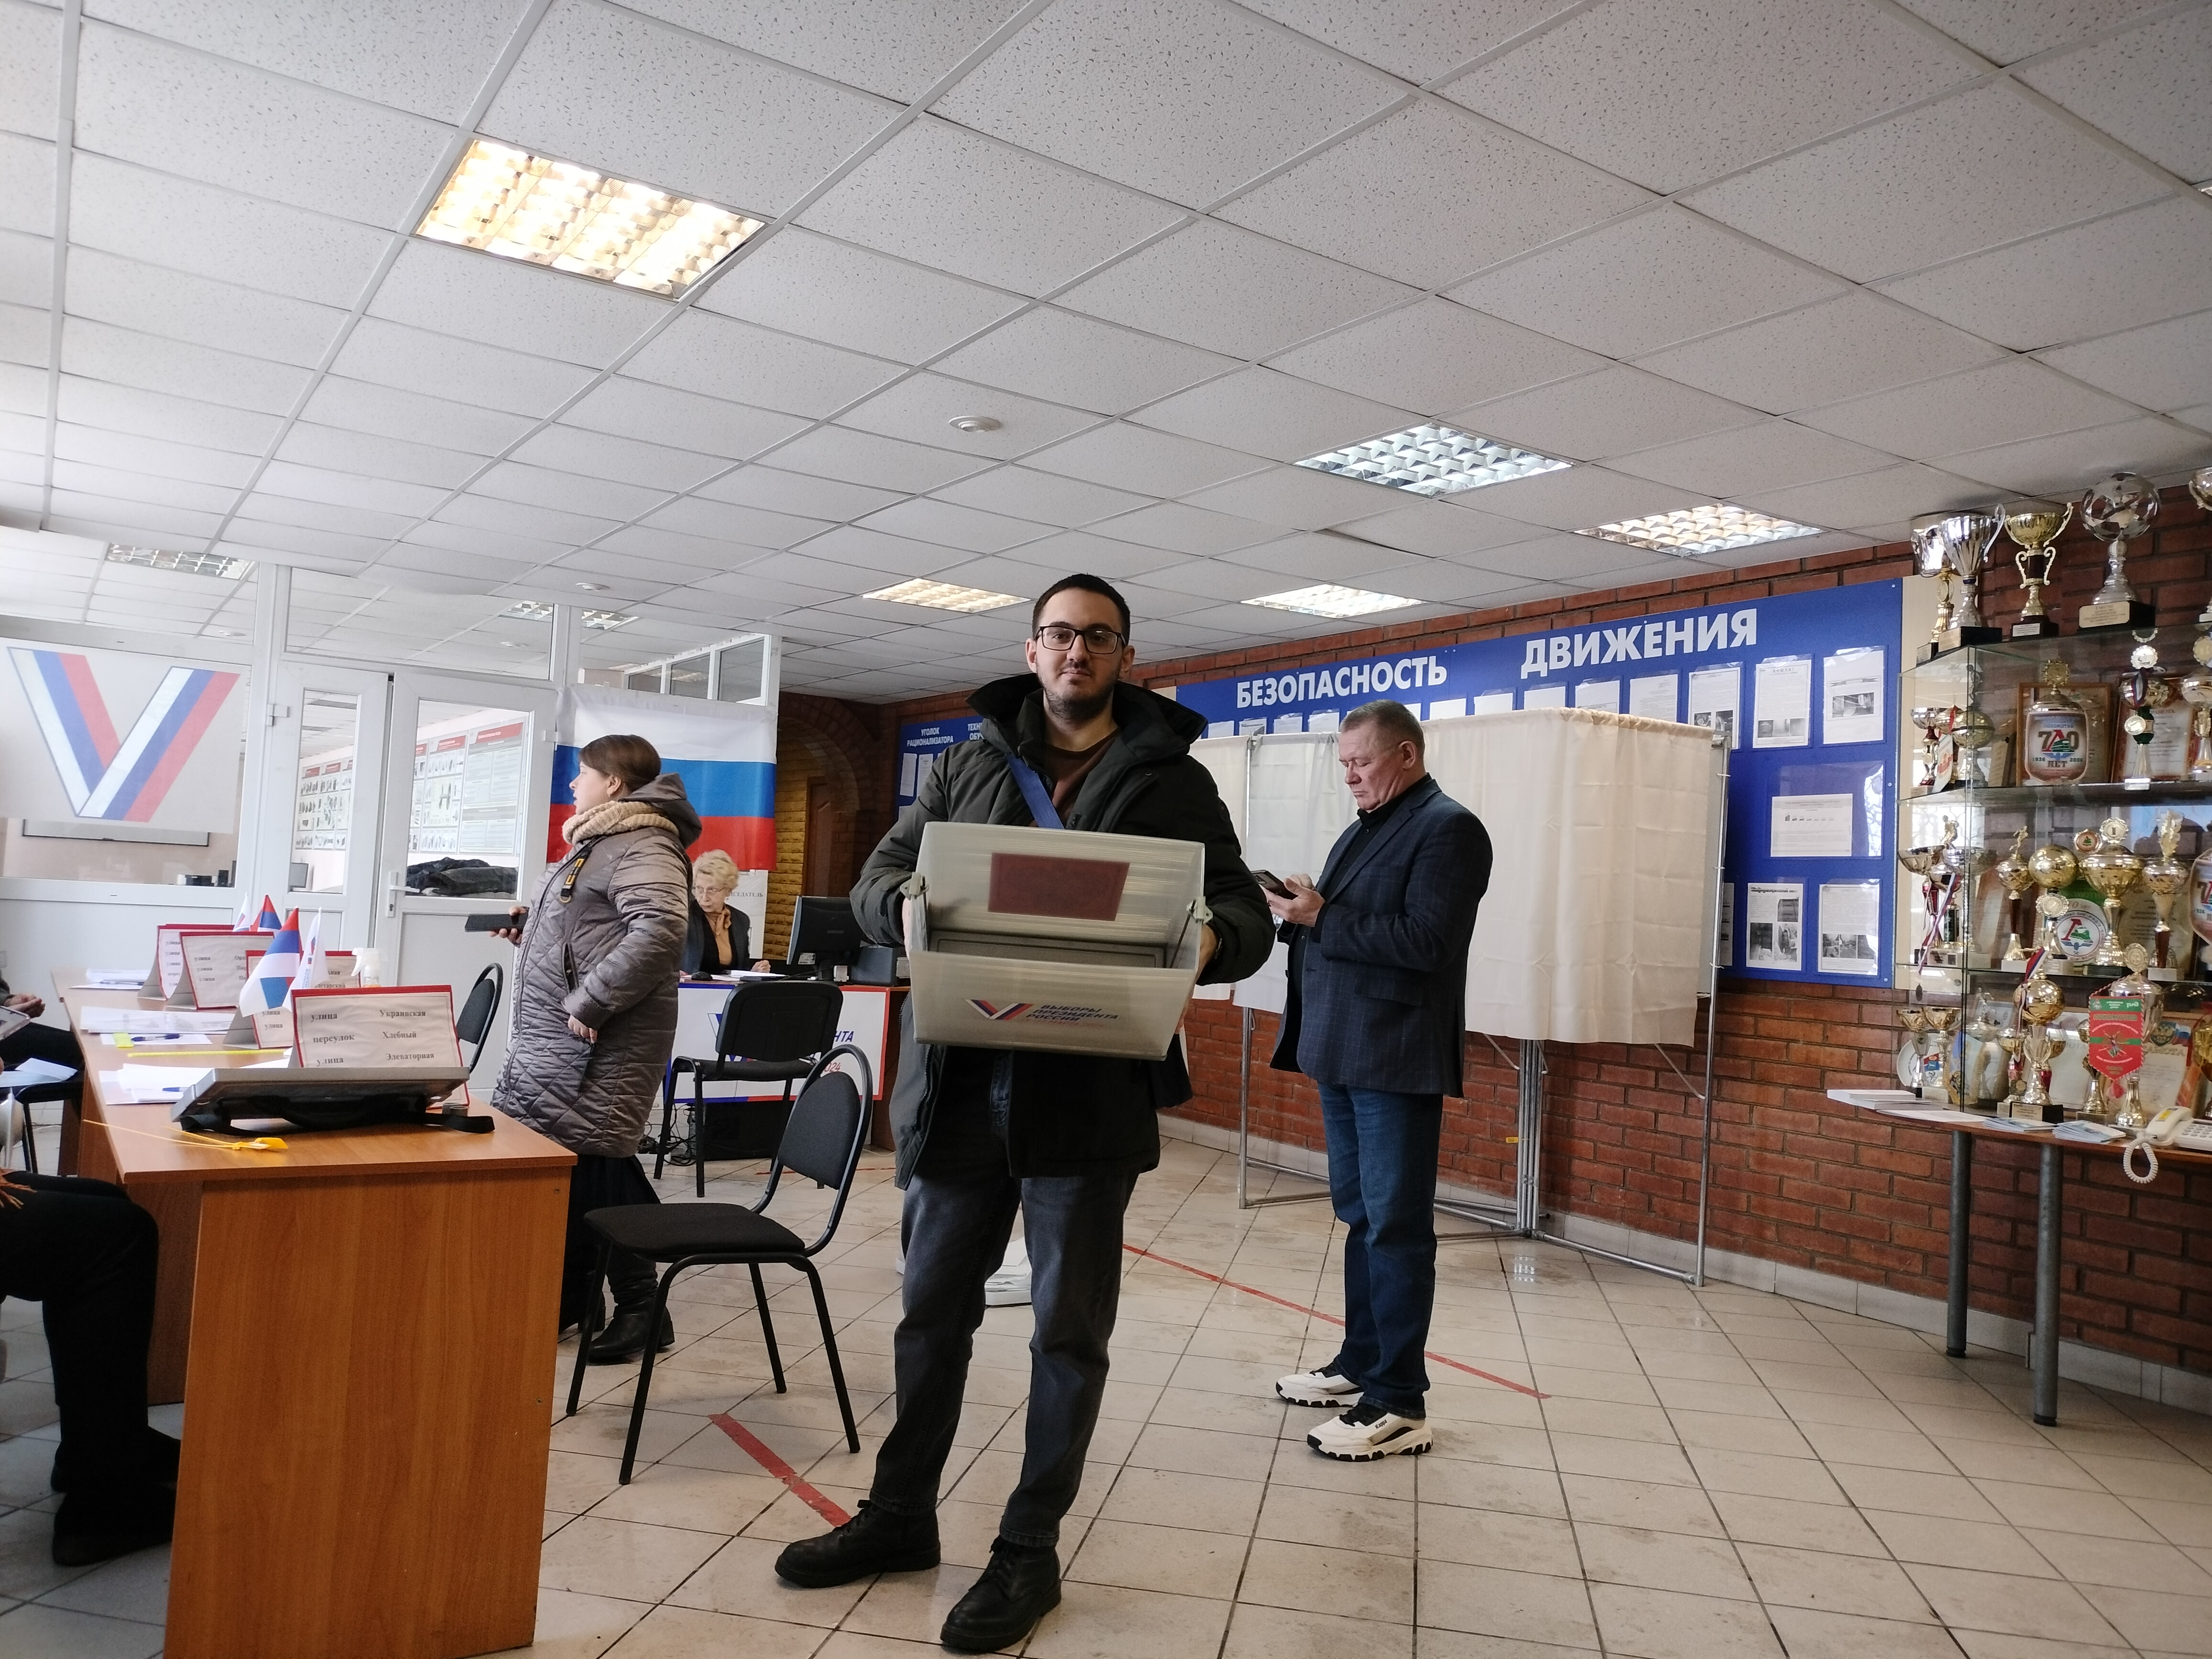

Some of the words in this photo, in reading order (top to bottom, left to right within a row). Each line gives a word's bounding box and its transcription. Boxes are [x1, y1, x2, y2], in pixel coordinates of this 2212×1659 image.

[1237, 655, 1447, 708] БЕЗОПАСНОСТЬ
[1520, 608, 1757, 679] ДВИЖЕНИЯ
[921, 727, 940, 736] УГОЛОК
[967, 722, 983, 731] ТЕХН
[907, 735, 954, 747] РАЦИОНАЛИЗАТОРА
[1033, 1009, 1118, 1019] ПРЕЗИДЕНТА
[1040, 1005, 1102, 1013] ВЫБОРЫ
[311, 1013, 337, 1022] улица
[379, 1009, 426, 1019] Украинская
[313, 1034, 355, 1044] переулок
[383, 1030, 417, 1039] Хлебный
[835, 1031, 854, 1042] НТА
[316, 1057, 344, 1067] улица
[385, 1052, 434, 1061] Элеваторная
[824, 1062, 841, 1072] 024
[1375, 1419, 1387, 1429] Kappa
